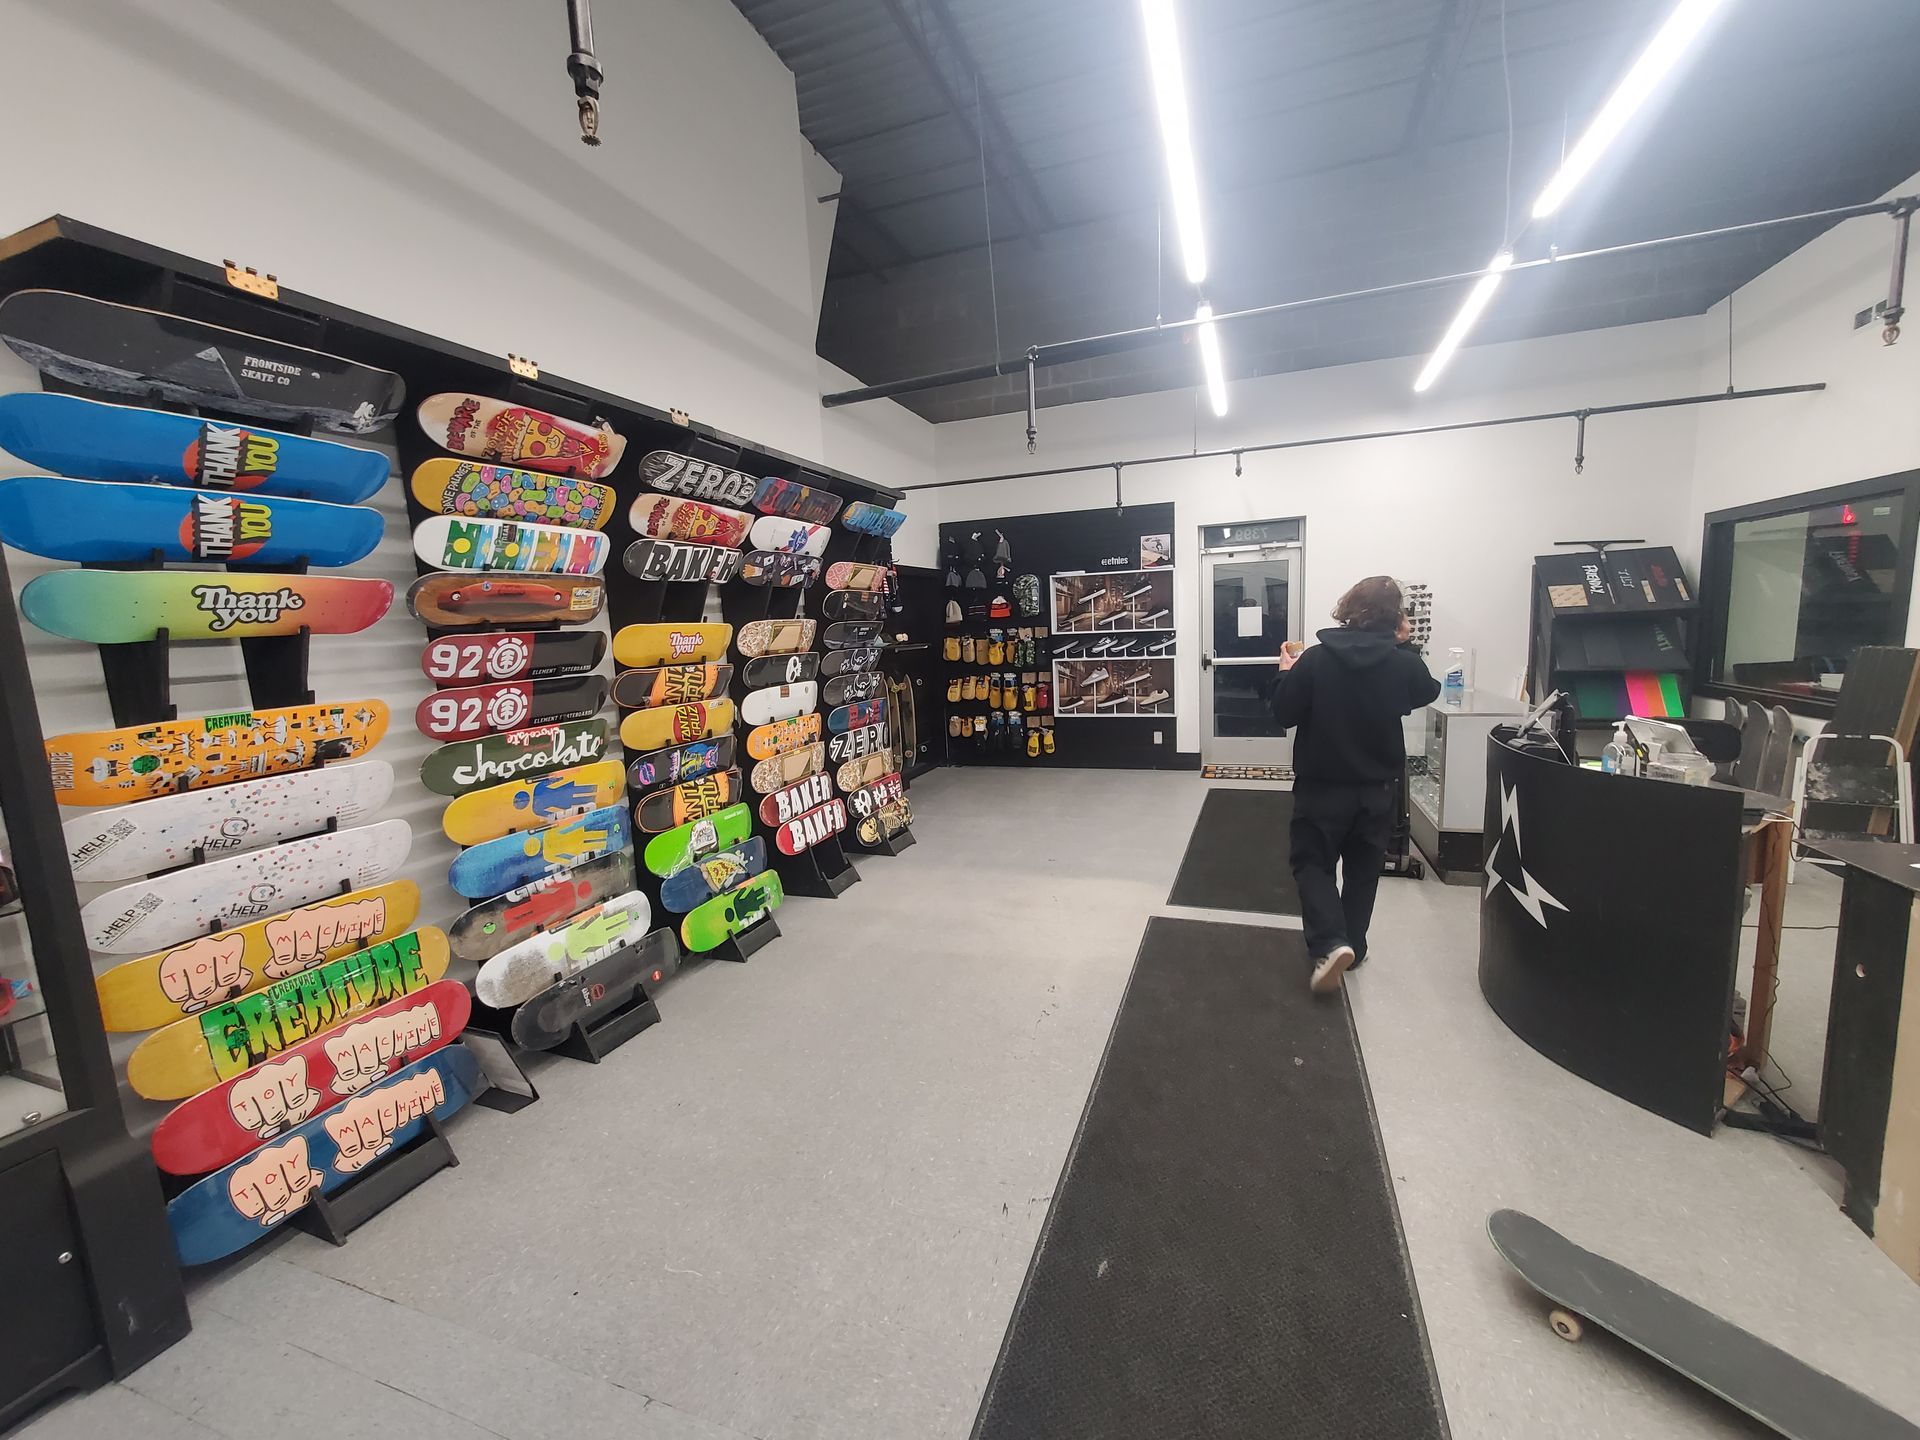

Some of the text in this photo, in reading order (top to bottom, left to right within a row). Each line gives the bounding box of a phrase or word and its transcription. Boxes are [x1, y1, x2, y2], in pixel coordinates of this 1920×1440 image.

[241, 368, 291, 386] SKATE CO
[244, 356, 302, 376] FRONTSIDE
[447, 398, 480, 451] BEWARE
[481, 410, 515, 457] ZOMBIE
[201, 422, 241, 486] THANK
[244, 435, 280, 472] YOU
[443, 462, 473, 514] DAVE PALMER
[651, 454, 747, 506] ZERO
[197, 493, 234, 558] THANK
[239, 502, 272, 540] YOU
[671, 503, 690, 532] OMBIE
[640, 541, 740, 584] BAKER
[1107, 556, 1129, 566] etnies
[193, 586, 304, 610] Thank
[212, 608, 279, 631] you
[670, 632, 703, 646] Thank
[672, 644, 695, 659] you
[531, 664, 592, 676] ELEMENT ATEBOARDS
[204, 713, 252, 733] CREATURE
[533, 709, 593, 725] ELEMENT ATEBOARDS
[676, 705, 692, 742] SANTA
[686, 705, 703, 737] CRUZ
[452, 729, 602, 785] chocolate
[775, 774, 832, 824] BAKER
[788, 800, 846, 853] BAKER
[72, 833, 109, 859] HELP
[202, 837, 242, 851] HELP
[102, 908, 137, 936] HELP
[229, 904, 269, 916] HELP
[164, 912, 383, 984] TOY MACHINE
[271, 971, 316, 1000] CREATURE
[199, 931, 430, 1083] CREATURE
[234, 1017, 438, 1112] TOY MACHINE
[235, 1084, 440, 1200] TOY MACHINE
